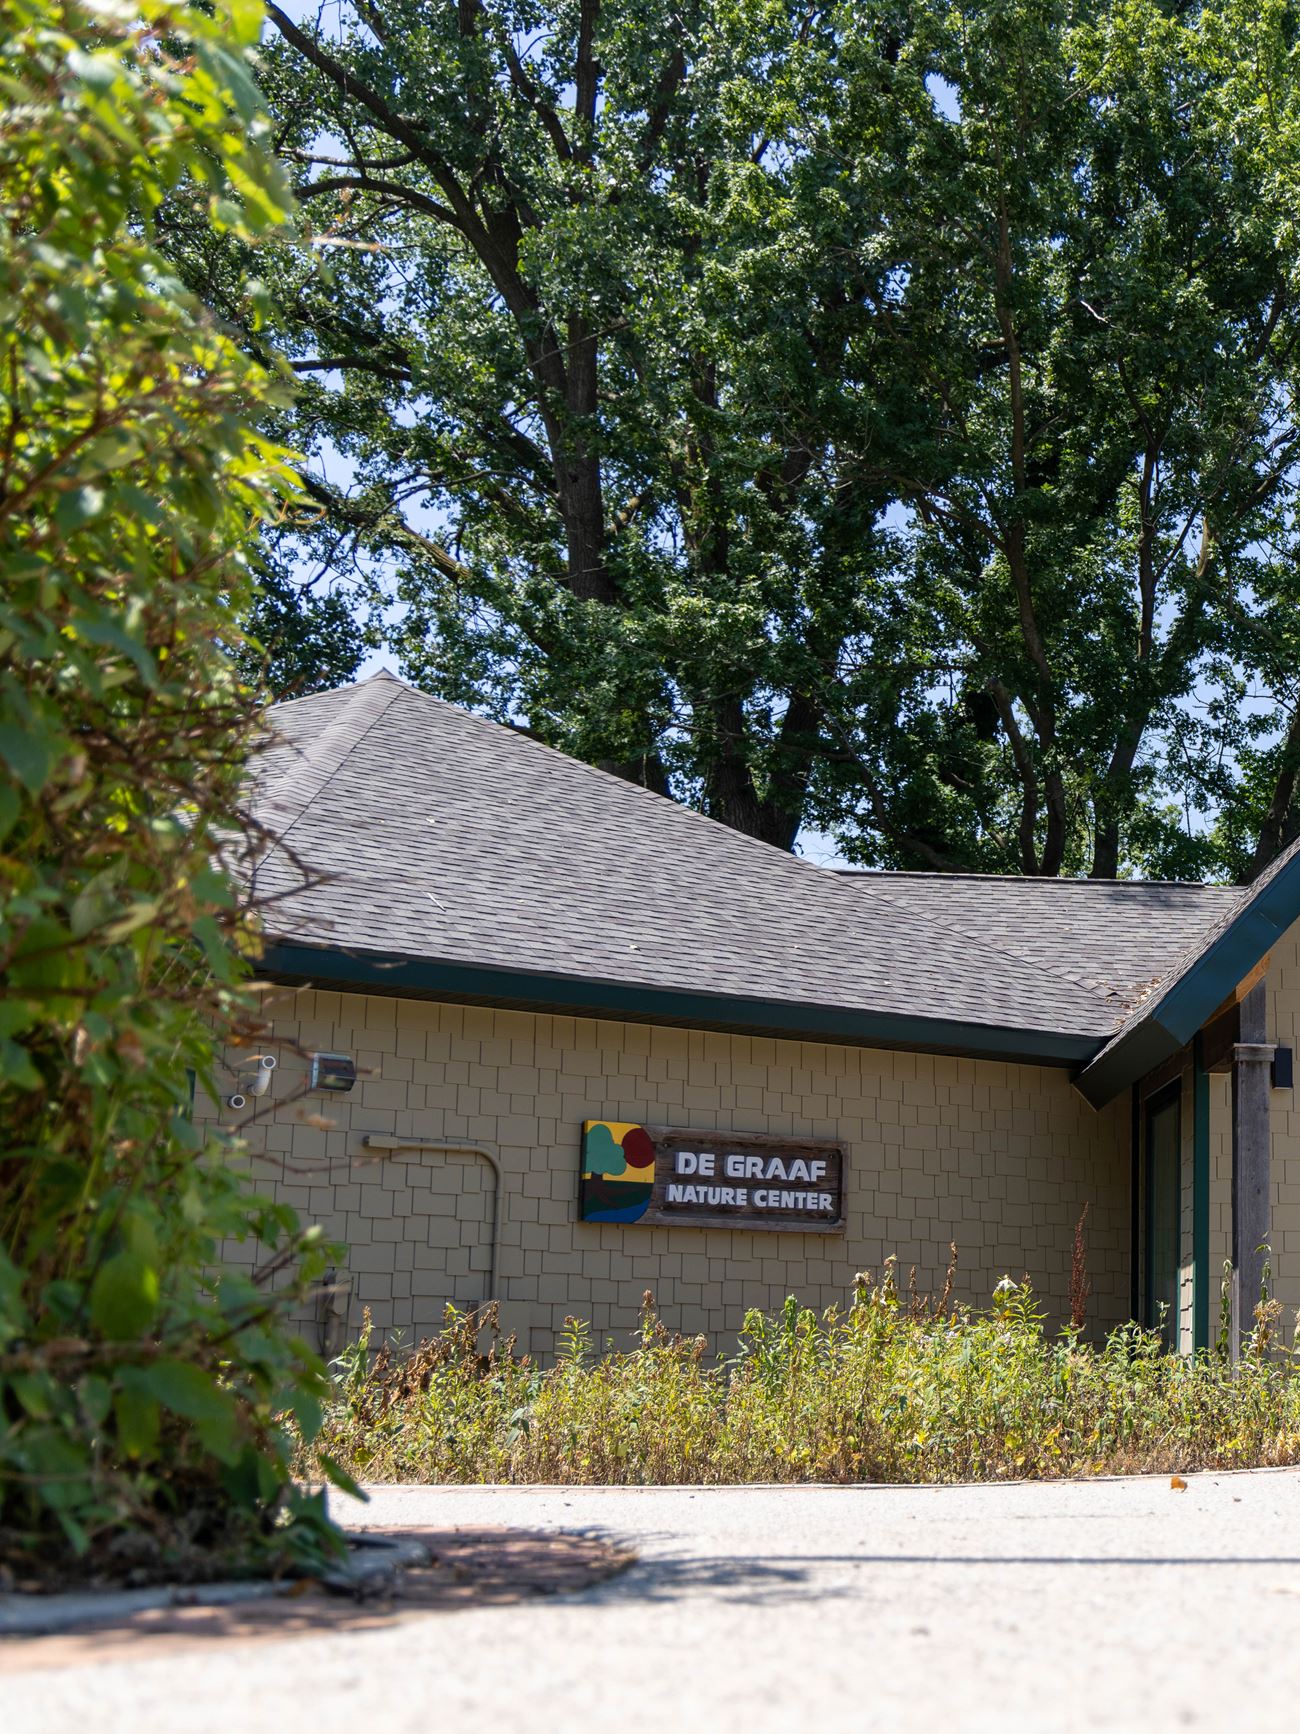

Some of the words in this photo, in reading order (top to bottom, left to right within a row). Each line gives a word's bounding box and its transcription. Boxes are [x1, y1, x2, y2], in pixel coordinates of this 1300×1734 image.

[675, 1151, 715, 1176] DE
[725, 1155, 826, 1182] GRAAF
[666, 1184, 747, 1206] NATURE
[753, 1189, 833, 1211] CENTER
